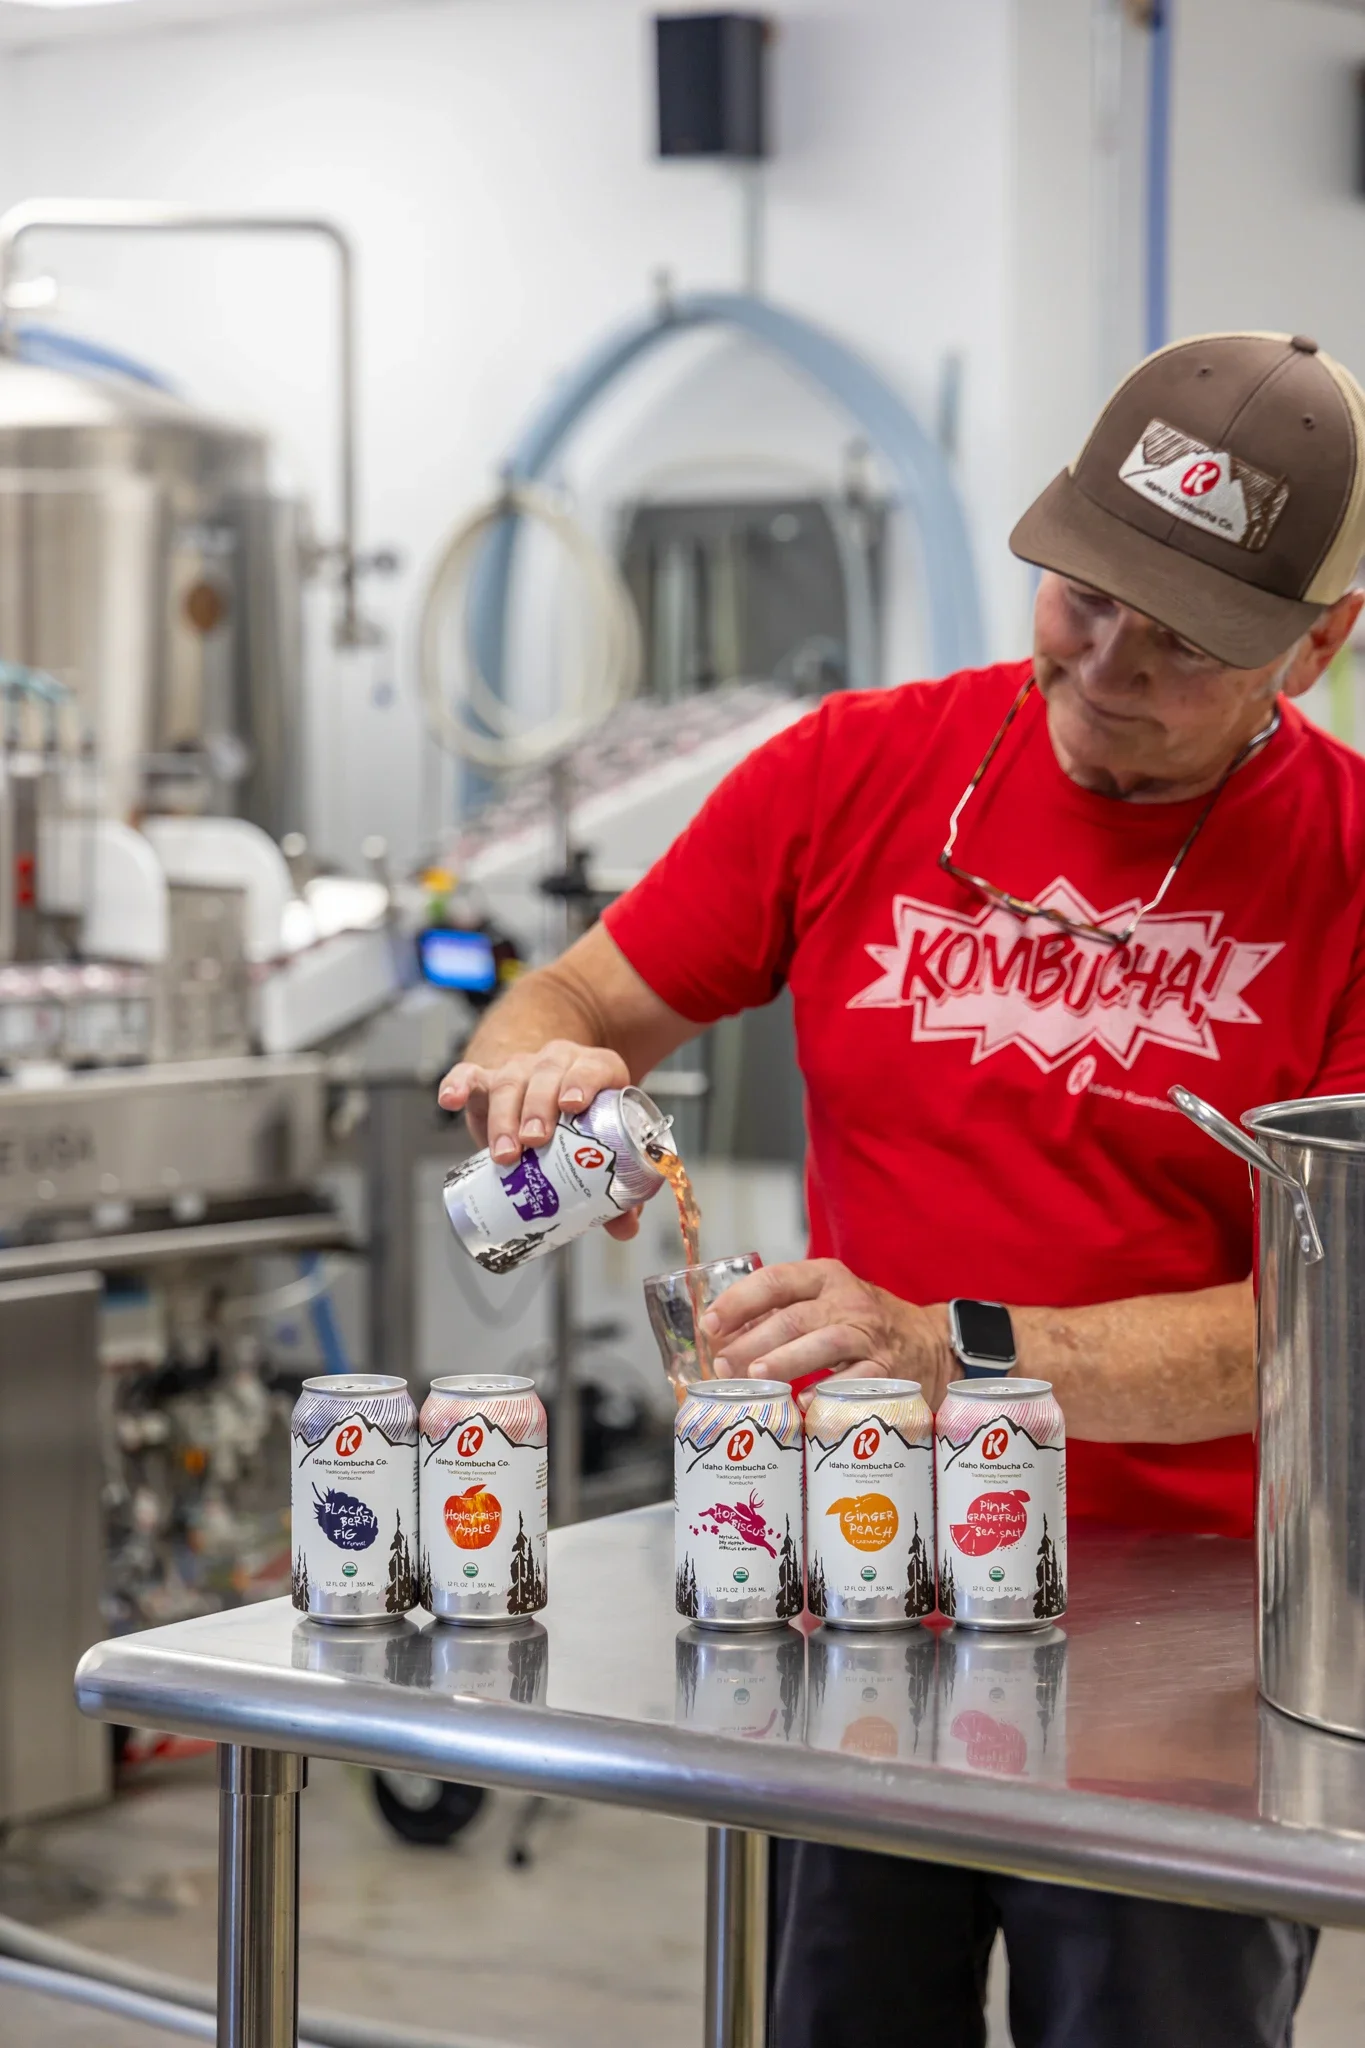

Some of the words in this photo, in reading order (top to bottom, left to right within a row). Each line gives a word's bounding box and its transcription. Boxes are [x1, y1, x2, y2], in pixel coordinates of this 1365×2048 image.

[901, 927, 1232, 1025] KOMBUCHA!
[565, 1153, 584, 1188] Kombucha
[312, 1458, 332, 1466] Idaho
[333, 1459, 374, 1467] Kombucha
[376, 1458, 388, 1466] Co.
[435, 1458, 454, 1466] Idaho
[497, 1459, 510, 1467] Co.
[702, 1463, 723, 1471] Idaho
[958, 1461, 978, 1469] Idaho
[324, 1502, 370, 1516] BLACK-
[714, 1508, 736, 1520] HOP
